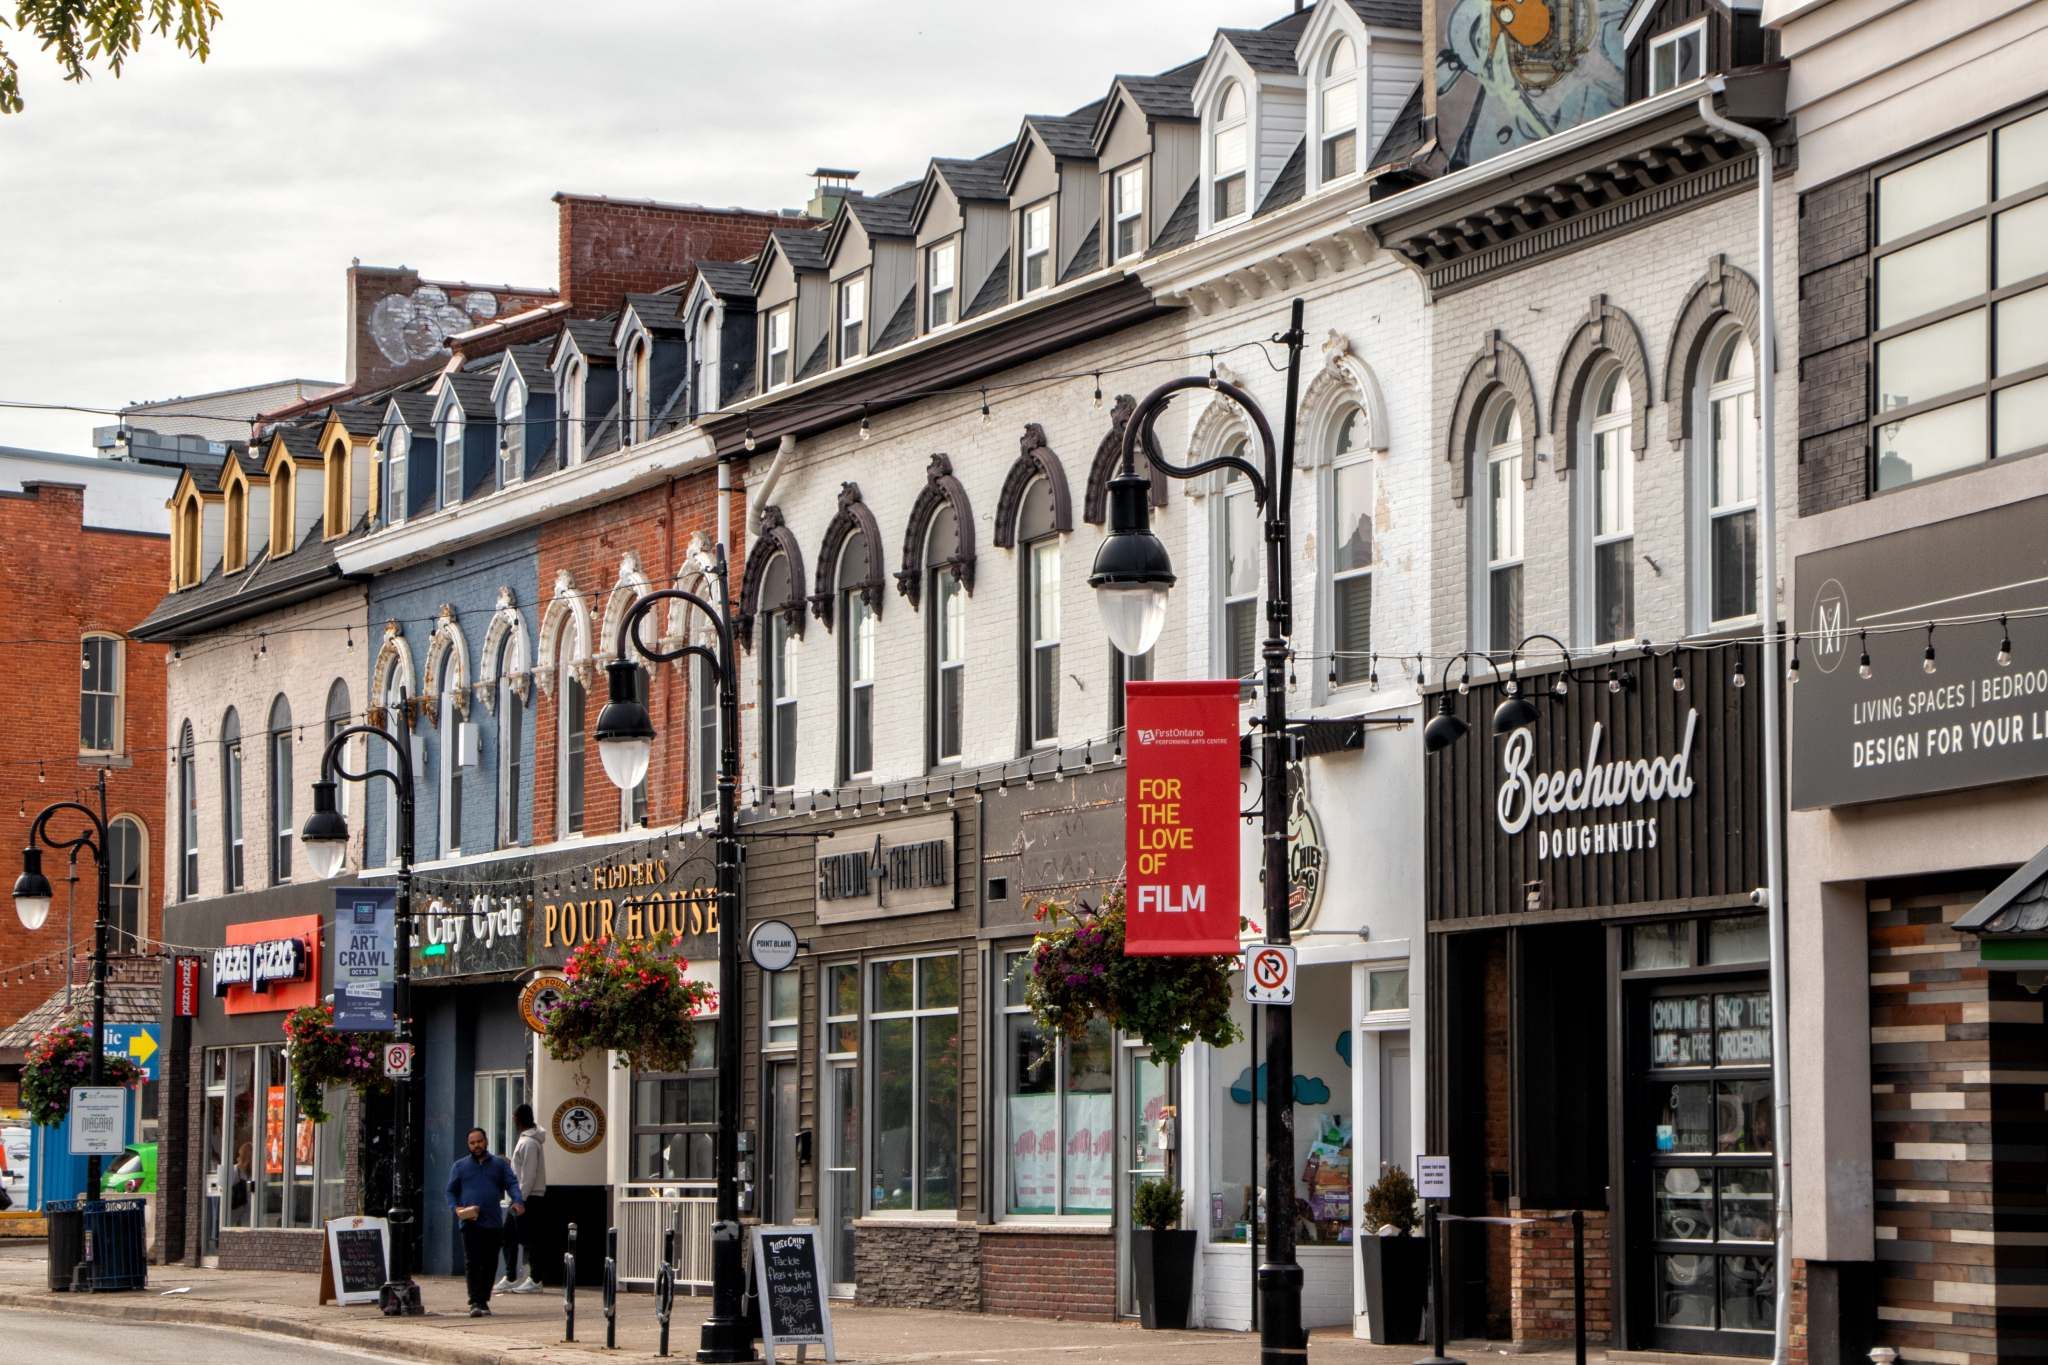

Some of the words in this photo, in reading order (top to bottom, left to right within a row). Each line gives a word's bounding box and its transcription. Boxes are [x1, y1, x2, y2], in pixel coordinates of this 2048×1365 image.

[1854, 695, 1902, 725] LIVING
[1908, 684, 1965, 716] SPACES
[1155, 728, 1204, 738] FirstOntario
[1853, 732, 1919, 768] DESIGN
[1927, 724, 1963, 757] FOR
[1971, 714, 2023, 750] YOUR
[1498, 708, 1696, 834] Beechwood
[1139, 779, 1181, 800] FOR
[1138, 803, 1180, 825] THE
[1139, 828, 1194, 850] LOVE
[1539, 818, 1656, 860] DOUGHNUTS
[594, 859, 667, 890] FIDDLER'S
[819, 851, 867, 900] STUDIO
[867, 833, 883, 908] 4
[1138, 853, 1167, 875] OF
[1138, 884, 1206, 913] FILM
[427, 901, 466, 952] City
[473, 894, 522, 949] Cycle
[545, 898, 615, 947] POUR
[627, 887, 718, 940] HOUSE
[350, 935, 378, 950] ART
[757, 939, 773, 947] POINT
[774, 939, 791, 947] BLANK
[340, 951, 389, 967] CRAWL
[183, 988, 192, 1016] pizza
[1717, 997, 1744, 1027] SKIP
[1692, 1032, 1711, 1060] PRE
[772, 1256, 800, 1266] Tackle
